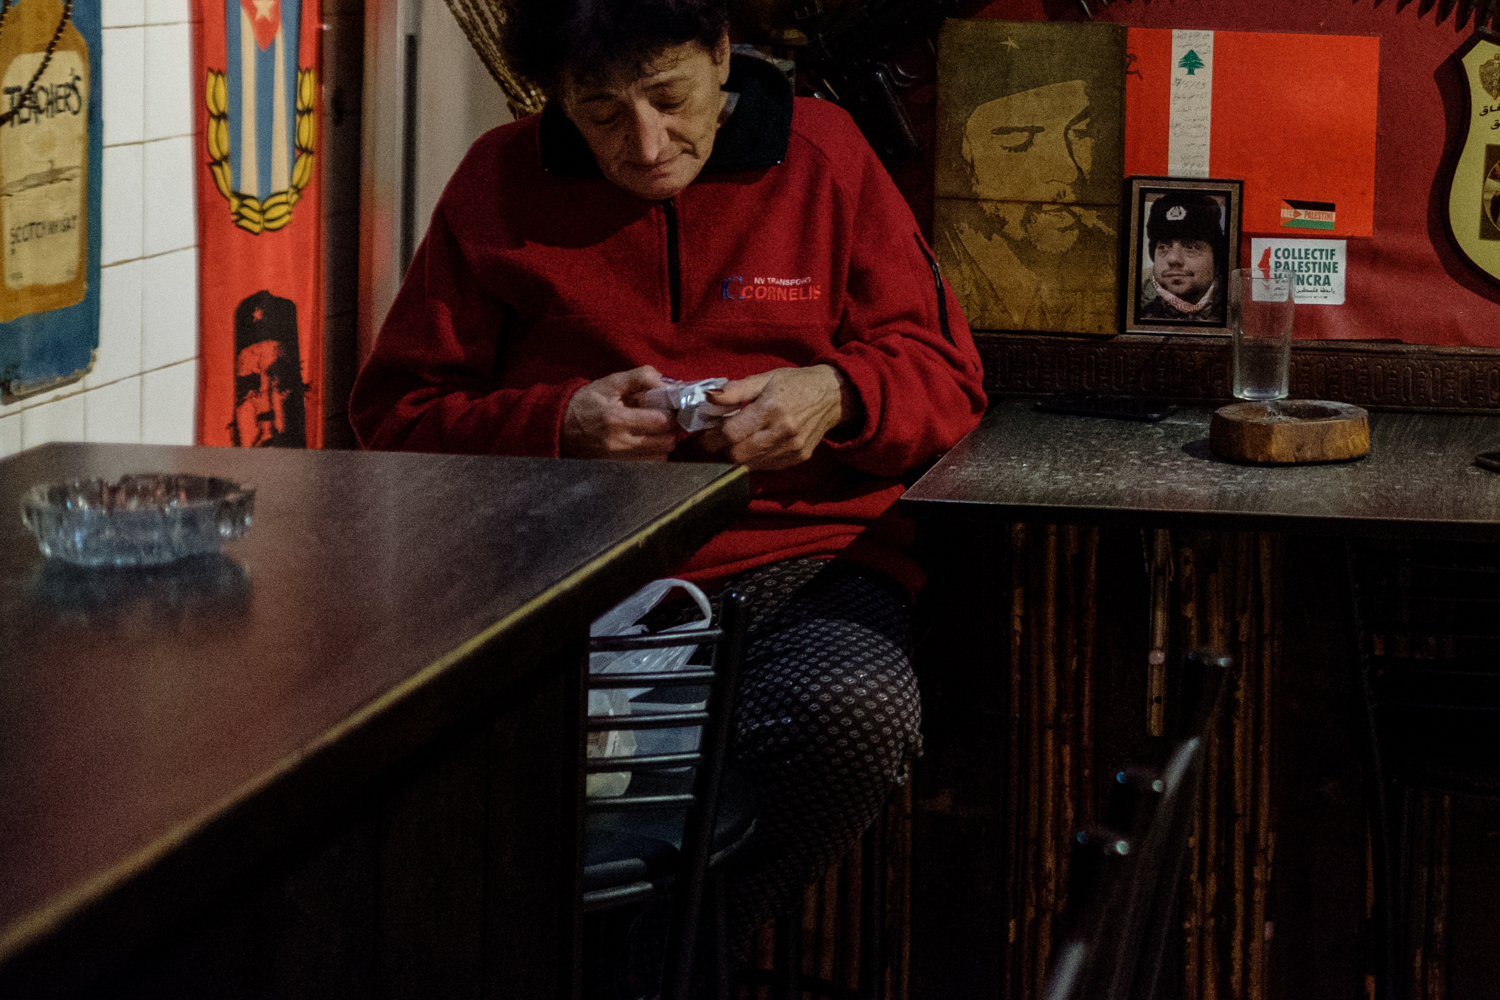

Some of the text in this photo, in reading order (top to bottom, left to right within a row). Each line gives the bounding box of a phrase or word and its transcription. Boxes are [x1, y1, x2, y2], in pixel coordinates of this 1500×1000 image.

[1304, 210, 1334, 221] PALESTINE
[1274, 247, 1336, 260] COLLECTIF
[1274, 260, 1339, 274] PALESTINE
